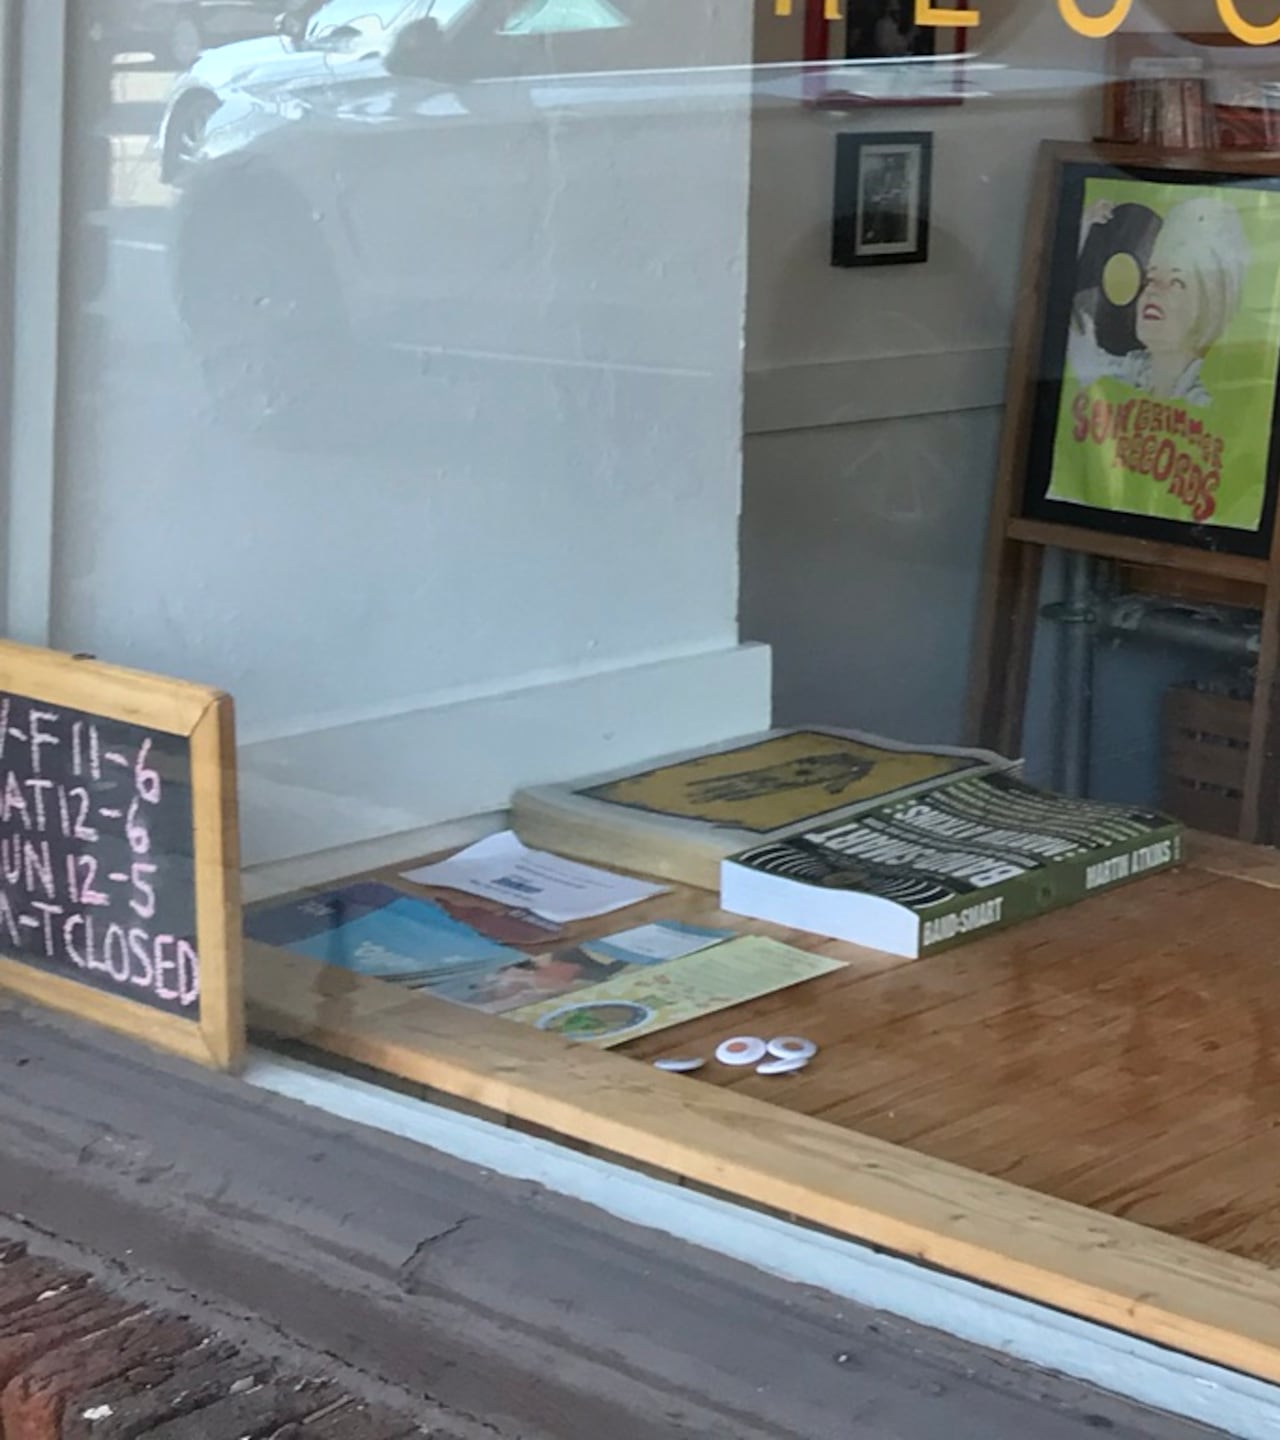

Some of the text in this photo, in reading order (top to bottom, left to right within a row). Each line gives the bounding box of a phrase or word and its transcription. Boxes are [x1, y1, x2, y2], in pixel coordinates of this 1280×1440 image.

[1114, 432, 1221, 523] RECORDS
[72, 720, 161, 804] 11-6
[0, 771, 151, 854] AT 12-6
[66, 853, 157, 919] 12-5
[63, 913, 200, 1006] CLOSED
